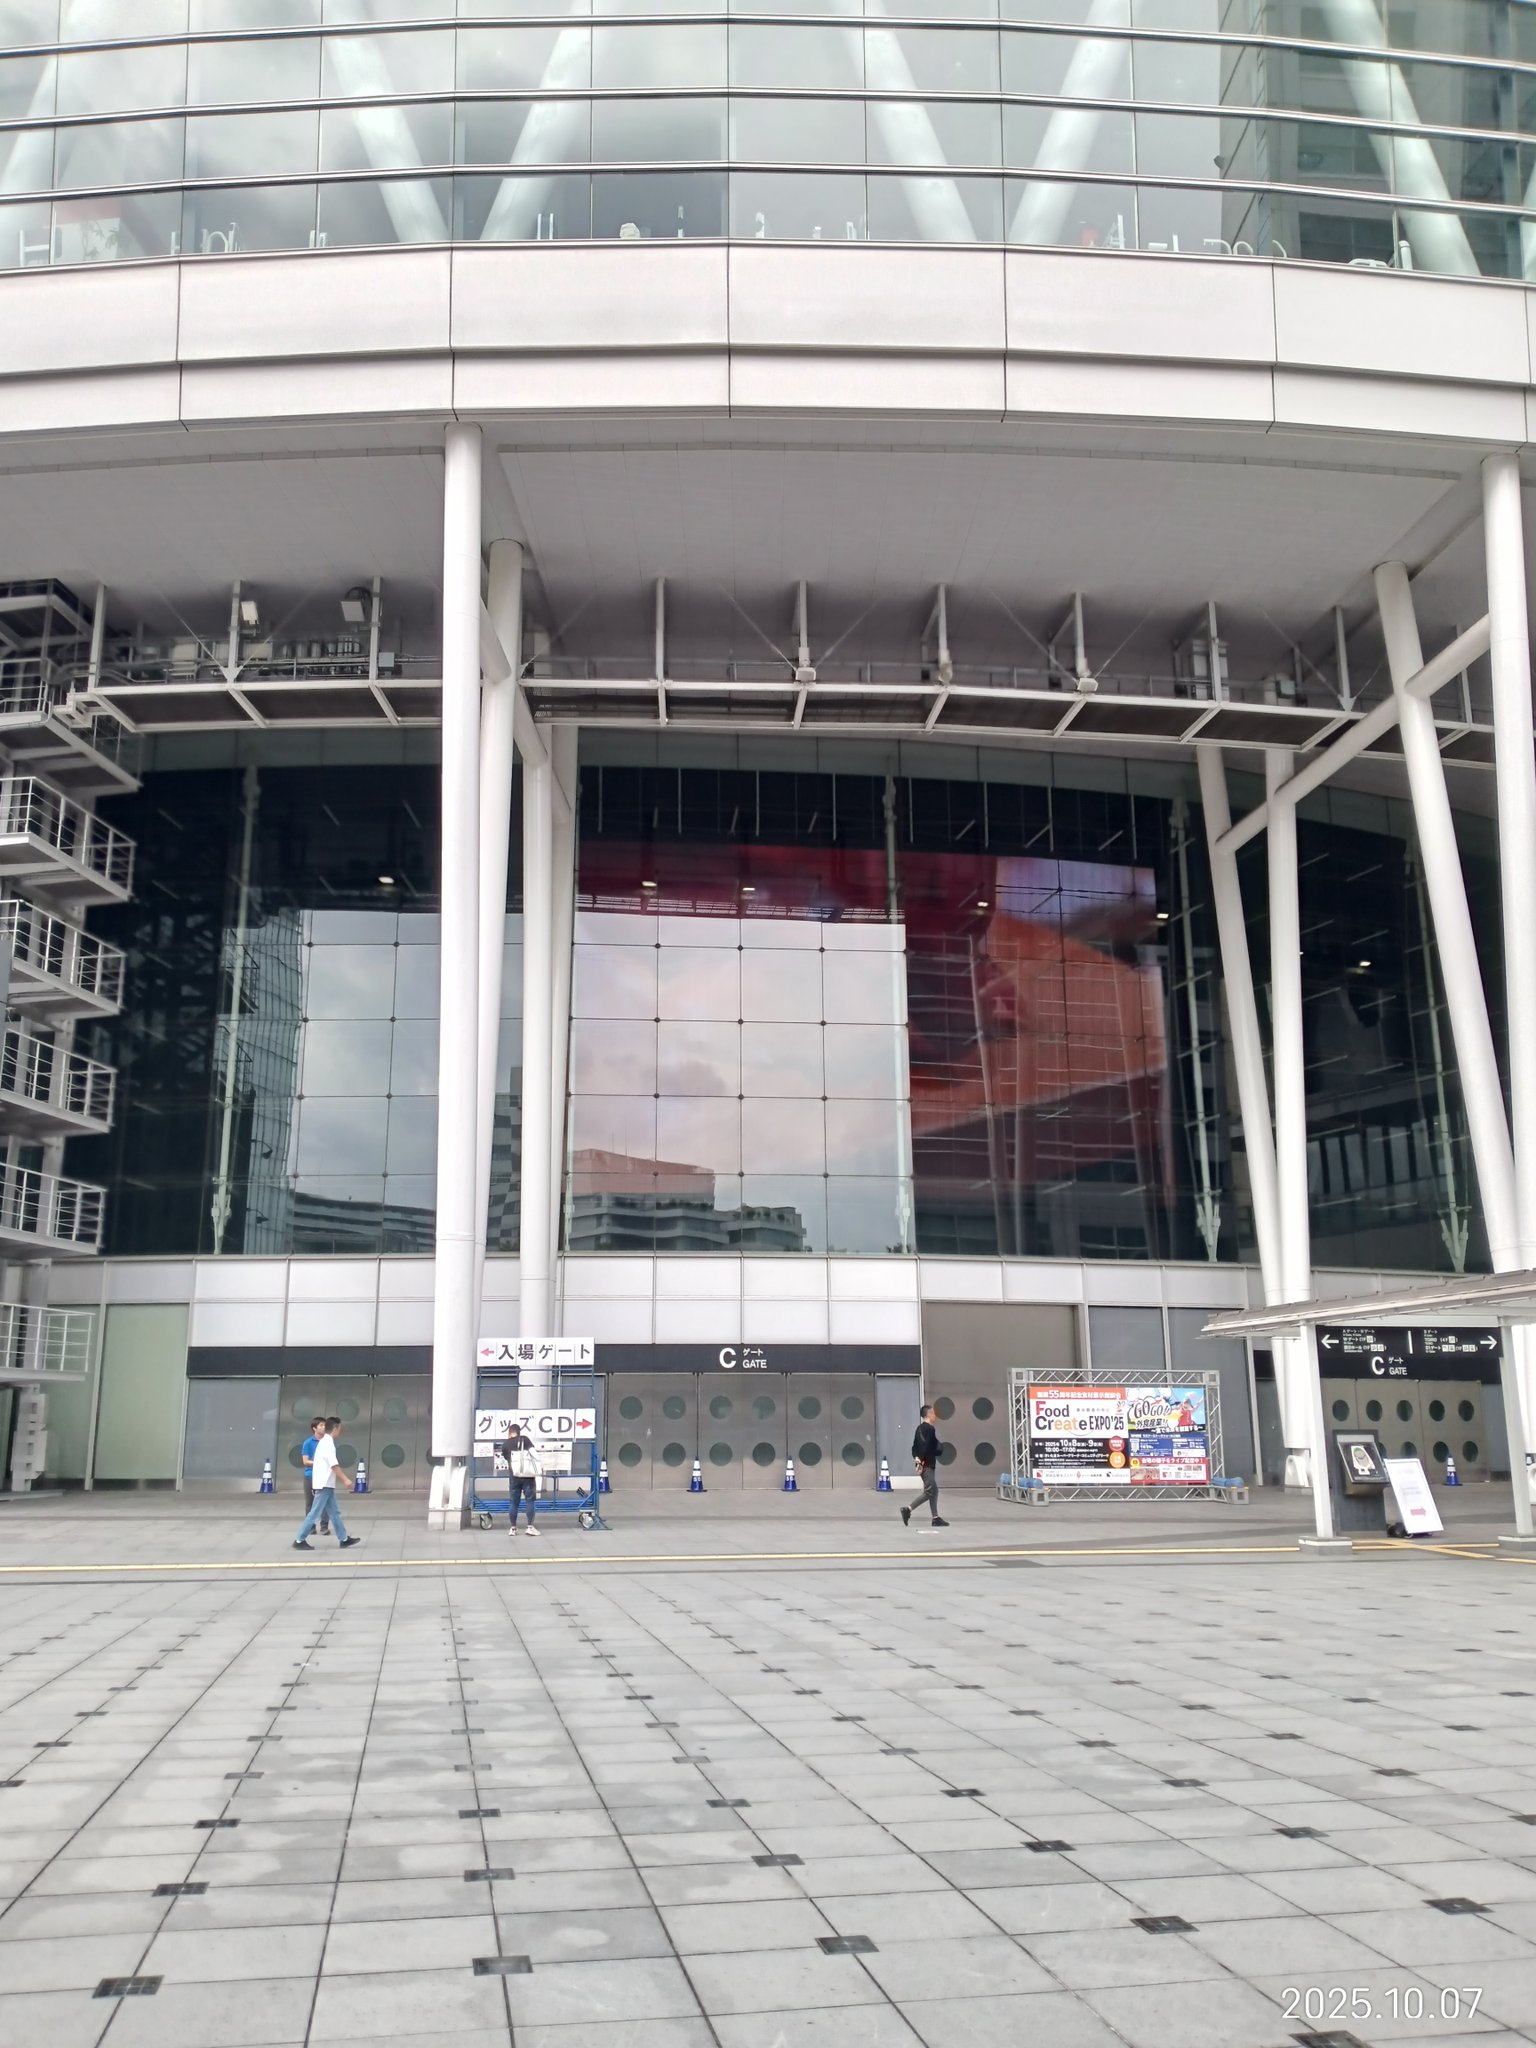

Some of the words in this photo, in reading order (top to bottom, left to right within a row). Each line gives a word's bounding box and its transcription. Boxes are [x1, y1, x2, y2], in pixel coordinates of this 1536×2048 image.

[498, 1343, 590, 1360] 入場ゲート
[718, 1348, 737, 1369] C
[742, 1348, 764, 1356] ゲート
[742, 1359, 768, 1369] GATE
[1371, 1356, 1385, 1375] C
[1389, 1367, 1408, 1375] GATE
[1035, 1401, 1070, 1417] Food
[1035, 1415, 1087, 1431] Create
[1089, 1416, 1124, 1430] EXPO'25
